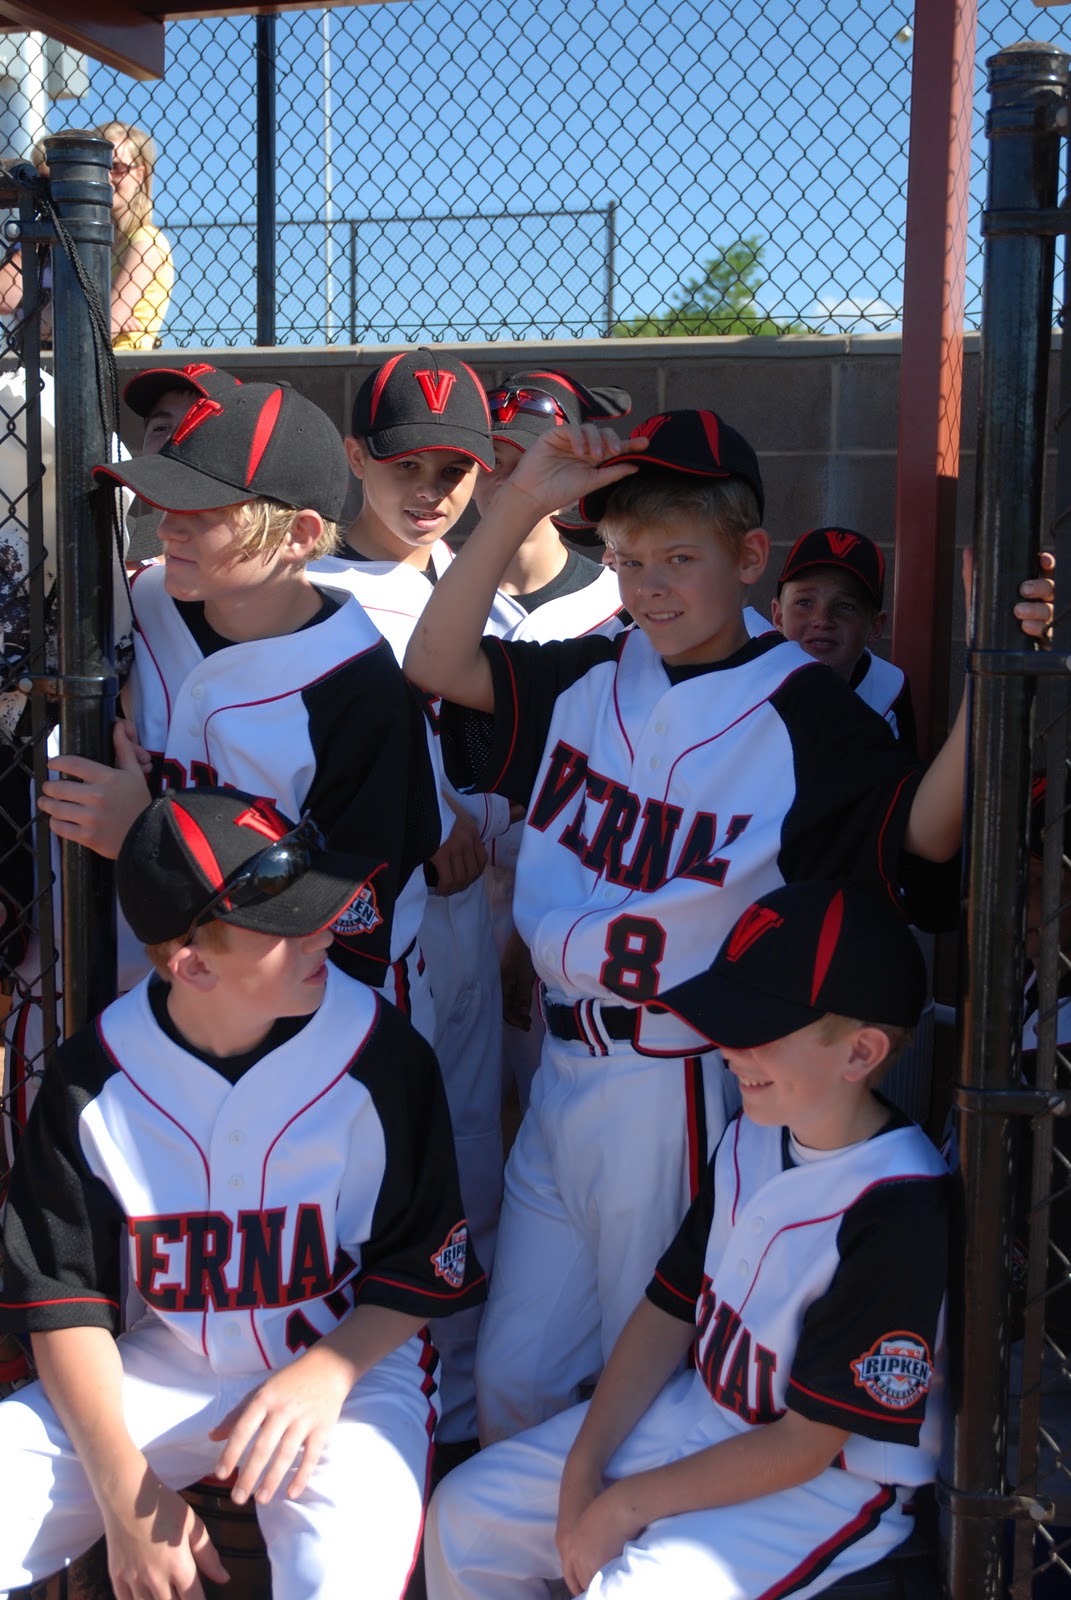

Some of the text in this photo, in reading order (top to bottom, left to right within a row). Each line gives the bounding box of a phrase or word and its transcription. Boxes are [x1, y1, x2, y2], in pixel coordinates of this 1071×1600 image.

[413, 369, 456, 414] V
[172, 398, 224, 446] V
[825, 531, 860, 558] V
[233, 800, 289, 842] V
[726, 903, 784, 962] V
[600, 913, 667, 1003] 8
[865, 1358, 928, 1380] RIPKEN
[886, 1346, 920, 1357] CAL
